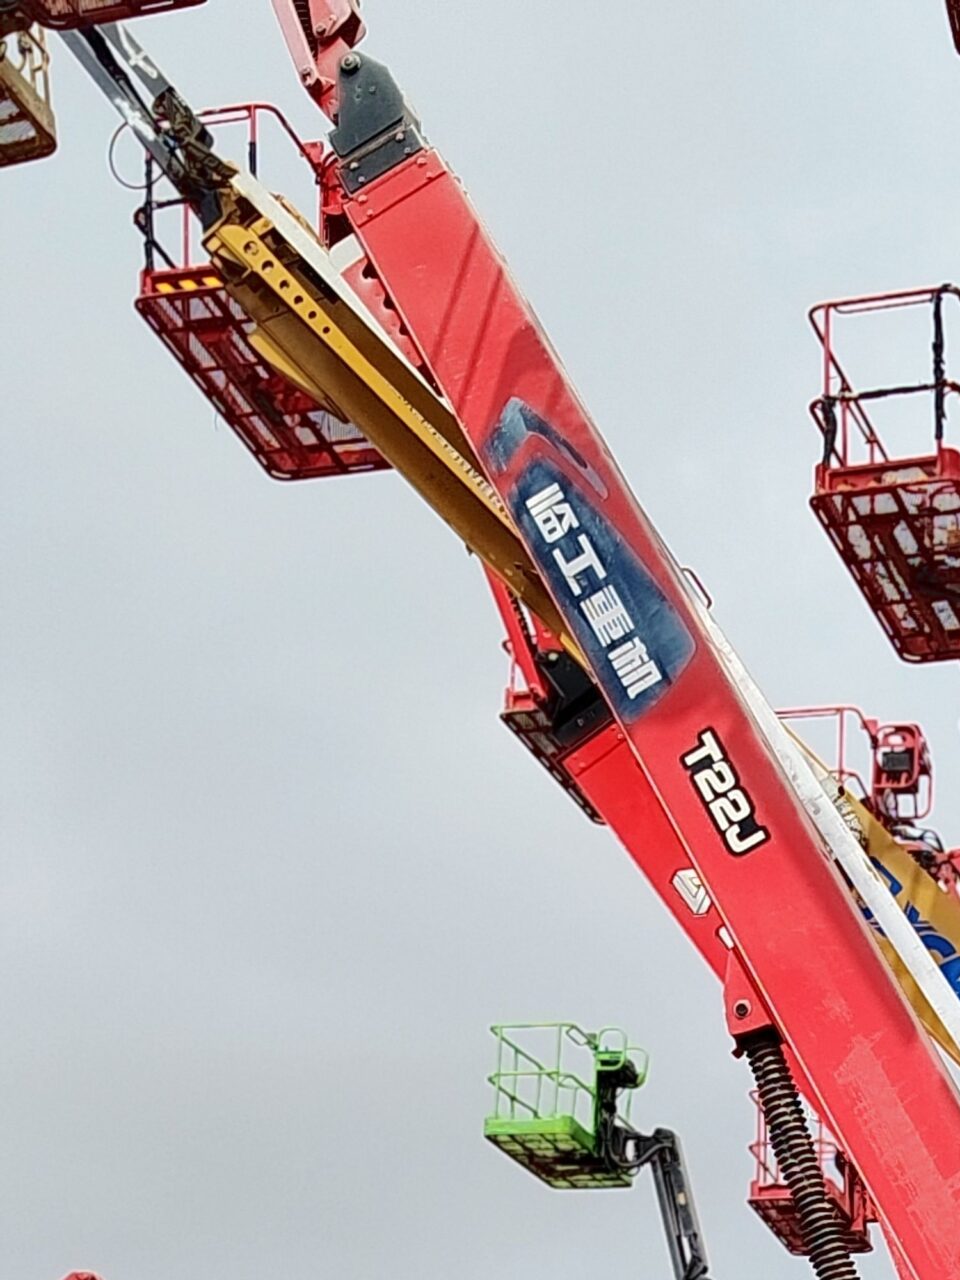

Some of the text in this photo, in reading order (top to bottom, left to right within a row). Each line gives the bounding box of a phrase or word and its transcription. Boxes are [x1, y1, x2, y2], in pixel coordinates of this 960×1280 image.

[524, 481, 664, 700] 临工重机
[683, 729, 767, 853] T22J
